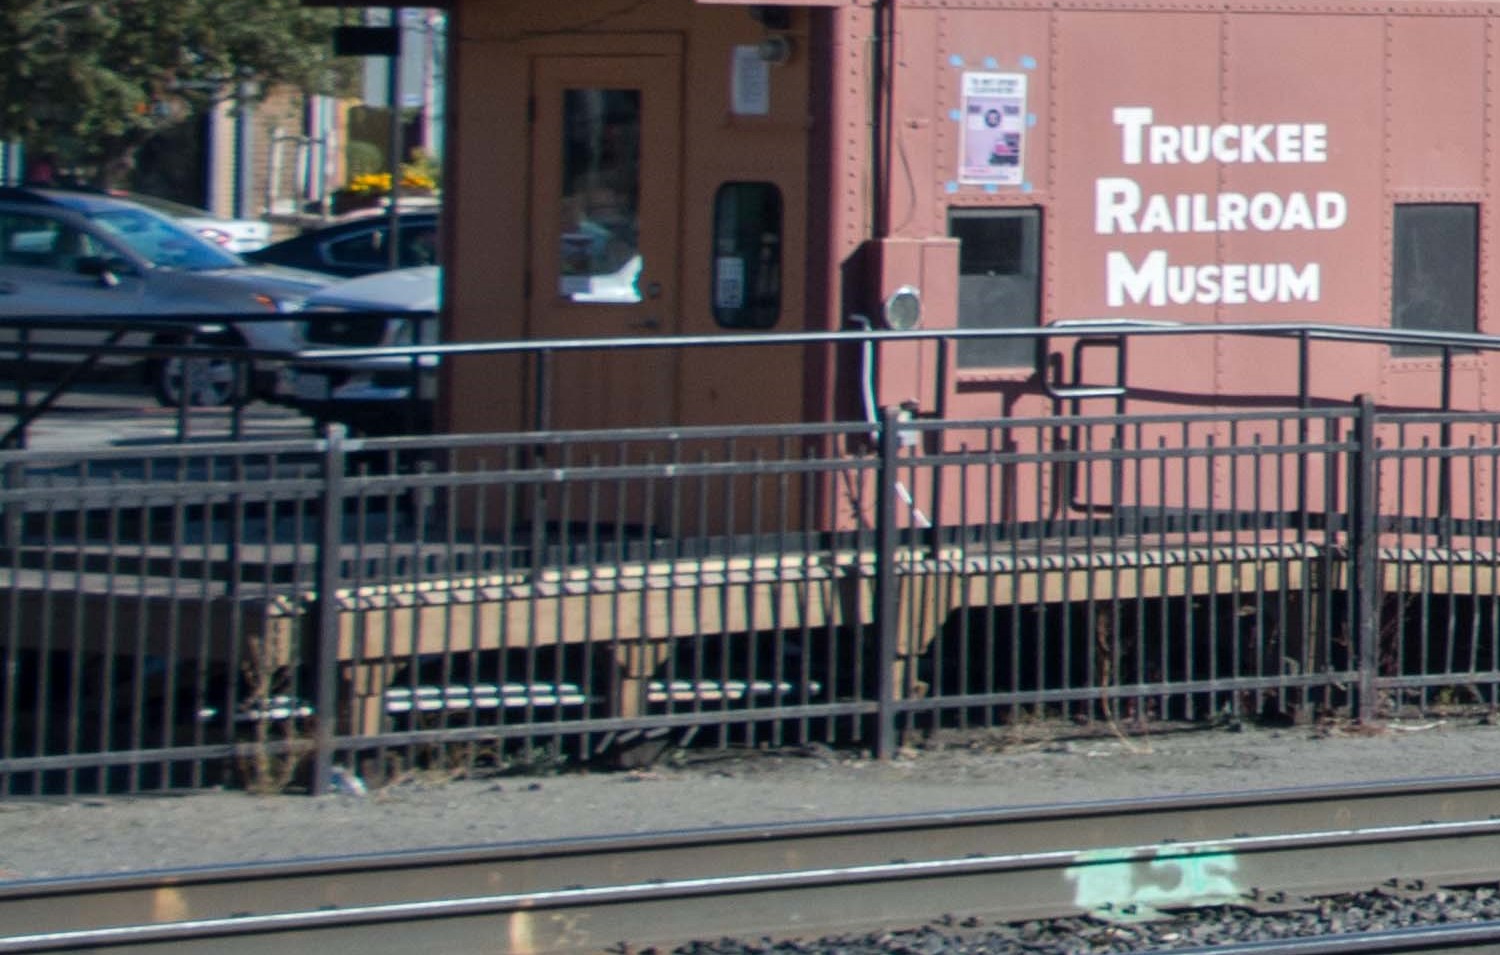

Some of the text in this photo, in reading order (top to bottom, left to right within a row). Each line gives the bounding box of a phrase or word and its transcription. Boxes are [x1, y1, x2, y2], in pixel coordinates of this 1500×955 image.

[1112, 106, 1329, 165] TRUCKEE
[1094, 177, 1349, 235] RAILROAD
[1106, 249, 1322, 308] MUSEUM
